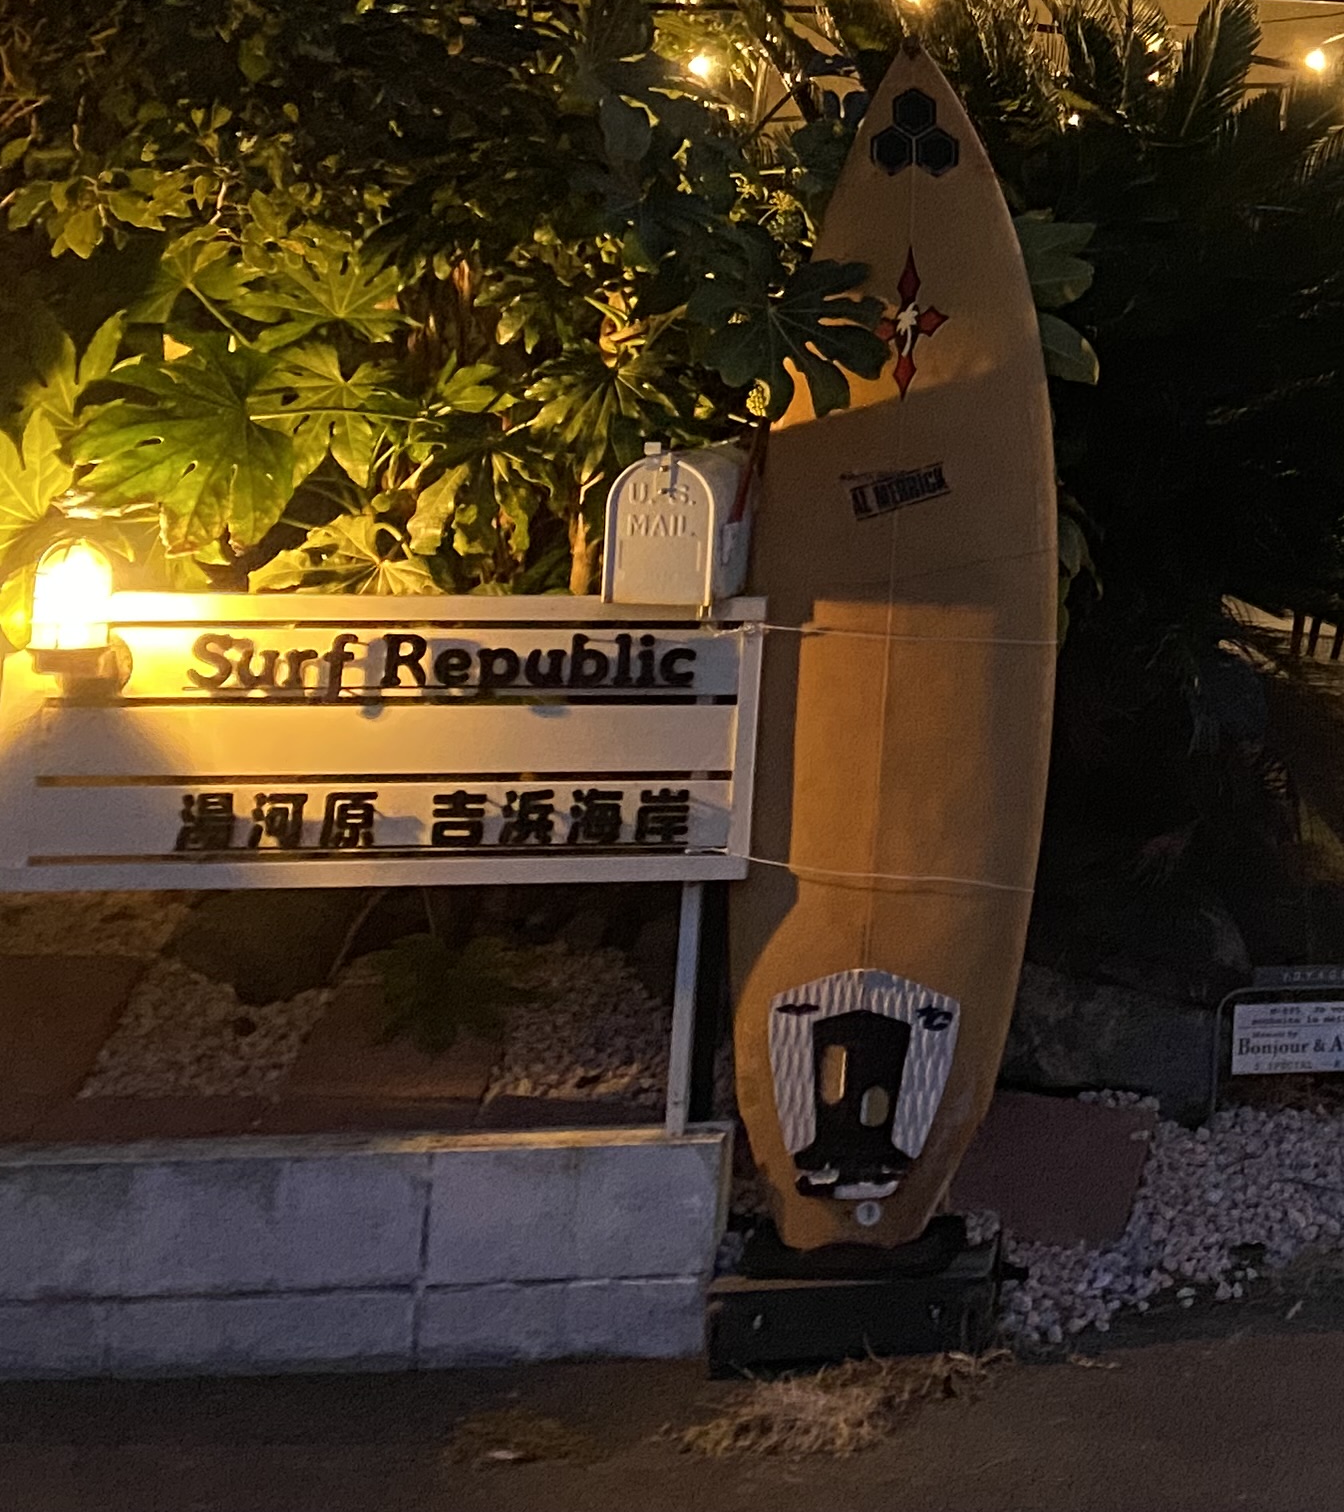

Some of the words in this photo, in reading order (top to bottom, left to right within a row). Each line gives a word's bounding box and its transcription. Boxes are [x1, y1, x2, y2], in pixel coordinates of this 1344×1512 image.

[187, 633, 358, 698] Surf
[381, 633, 697, 697] Republic
[175, 792, 378, 851] 湯河原
[431, 789, 690, 845] 吉浜海岸
[1238, 1037, 1309, 1058] Bonjour
[1313, 1038, 1326, 1053] &
